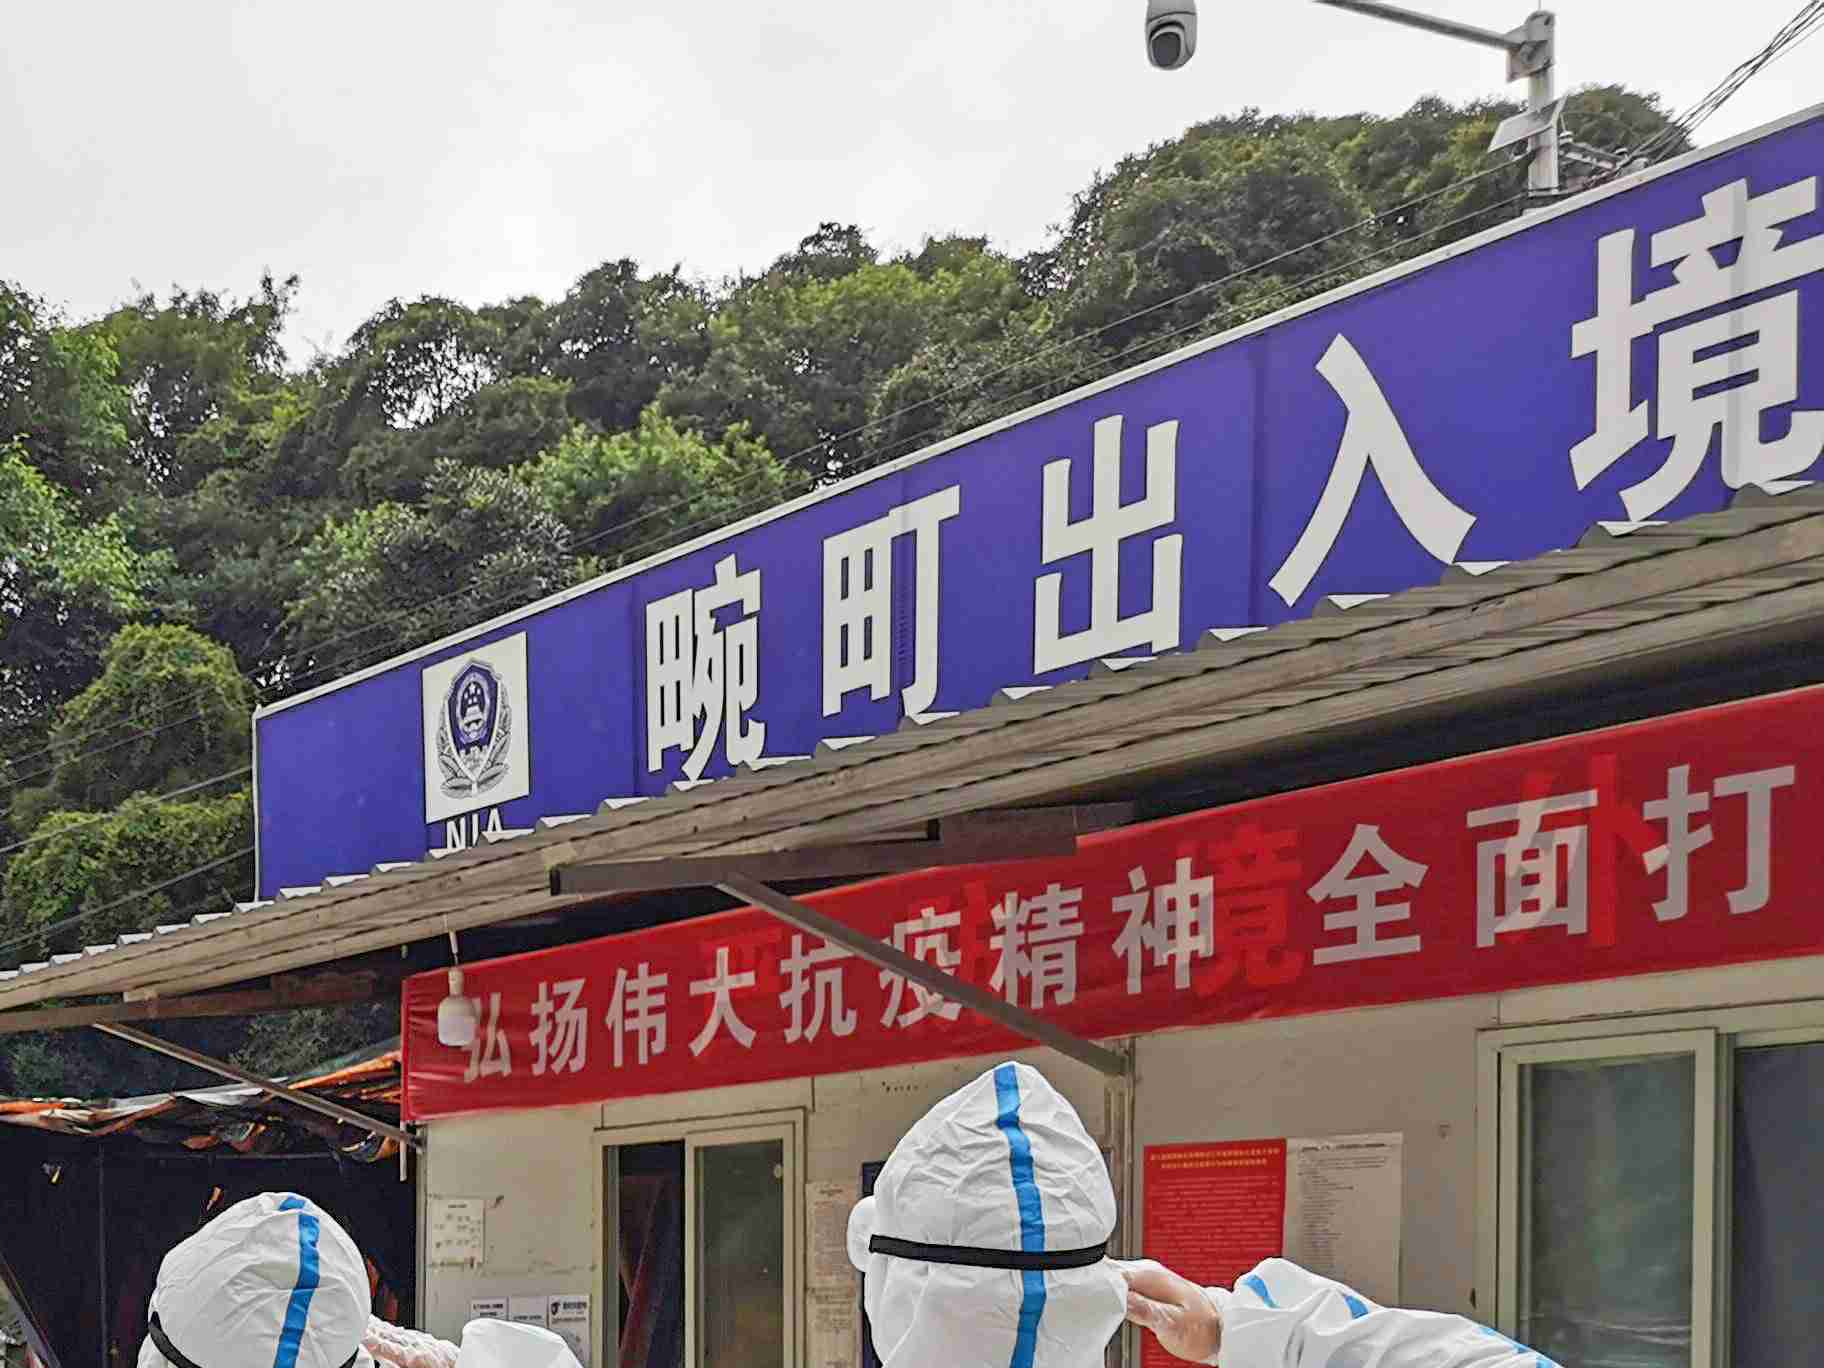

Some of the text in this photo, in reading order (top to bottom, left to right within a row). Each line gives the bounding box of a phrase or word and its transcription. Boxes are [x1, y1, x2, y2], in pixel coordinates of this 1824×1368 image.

[644, 176, 1824, 782] 畹町出入境
[446, 807, 503, 849] NIA
